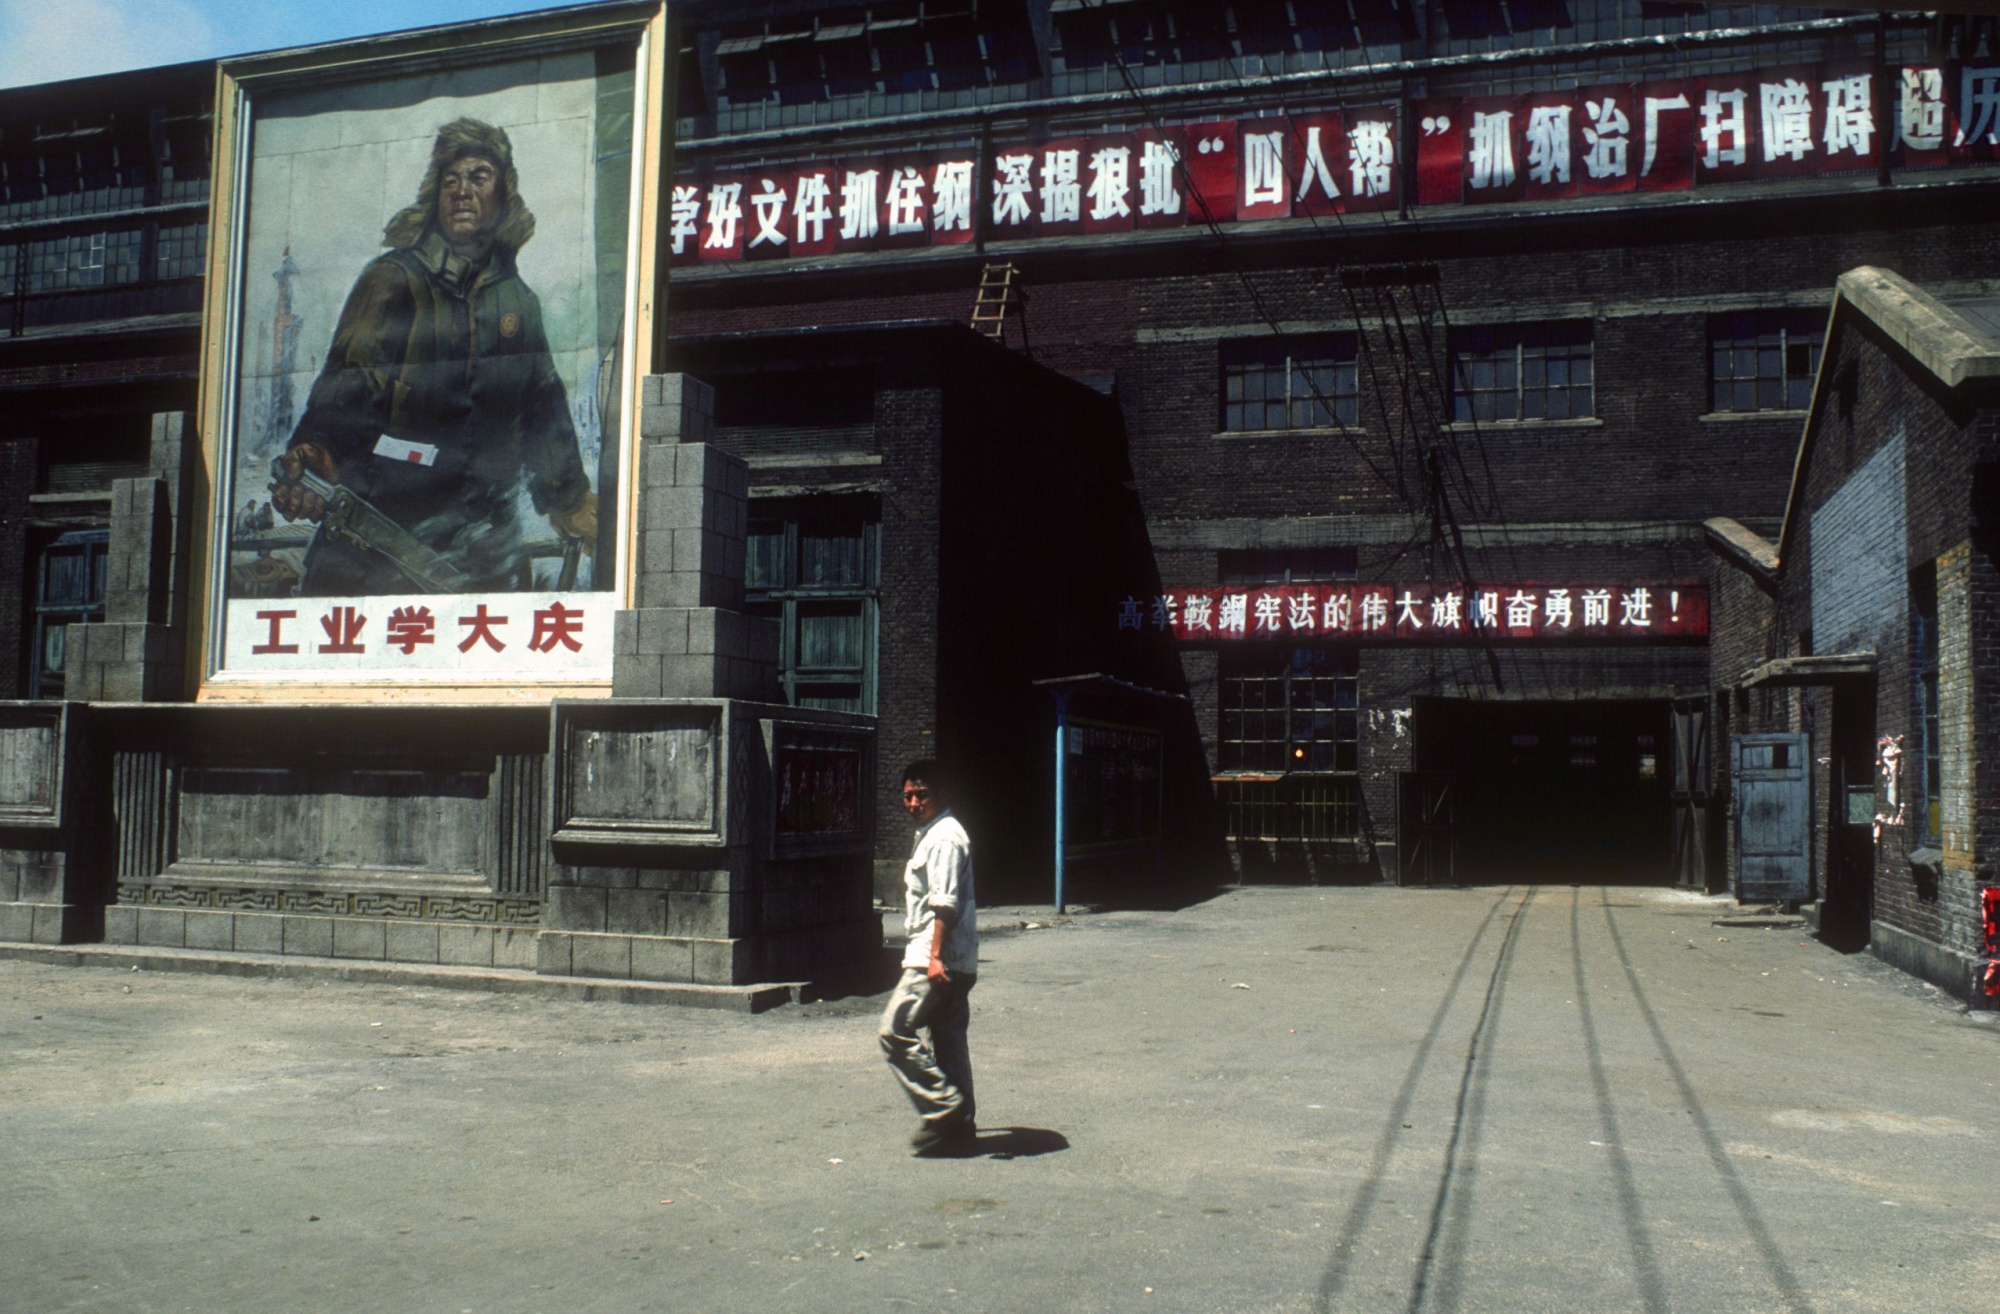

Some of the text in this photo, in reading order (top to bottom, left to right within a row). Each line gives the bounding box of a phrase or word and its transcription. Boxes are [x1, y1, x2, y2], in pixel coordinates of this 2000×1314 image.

[252, 601, 584, 655] 工业学大庆
